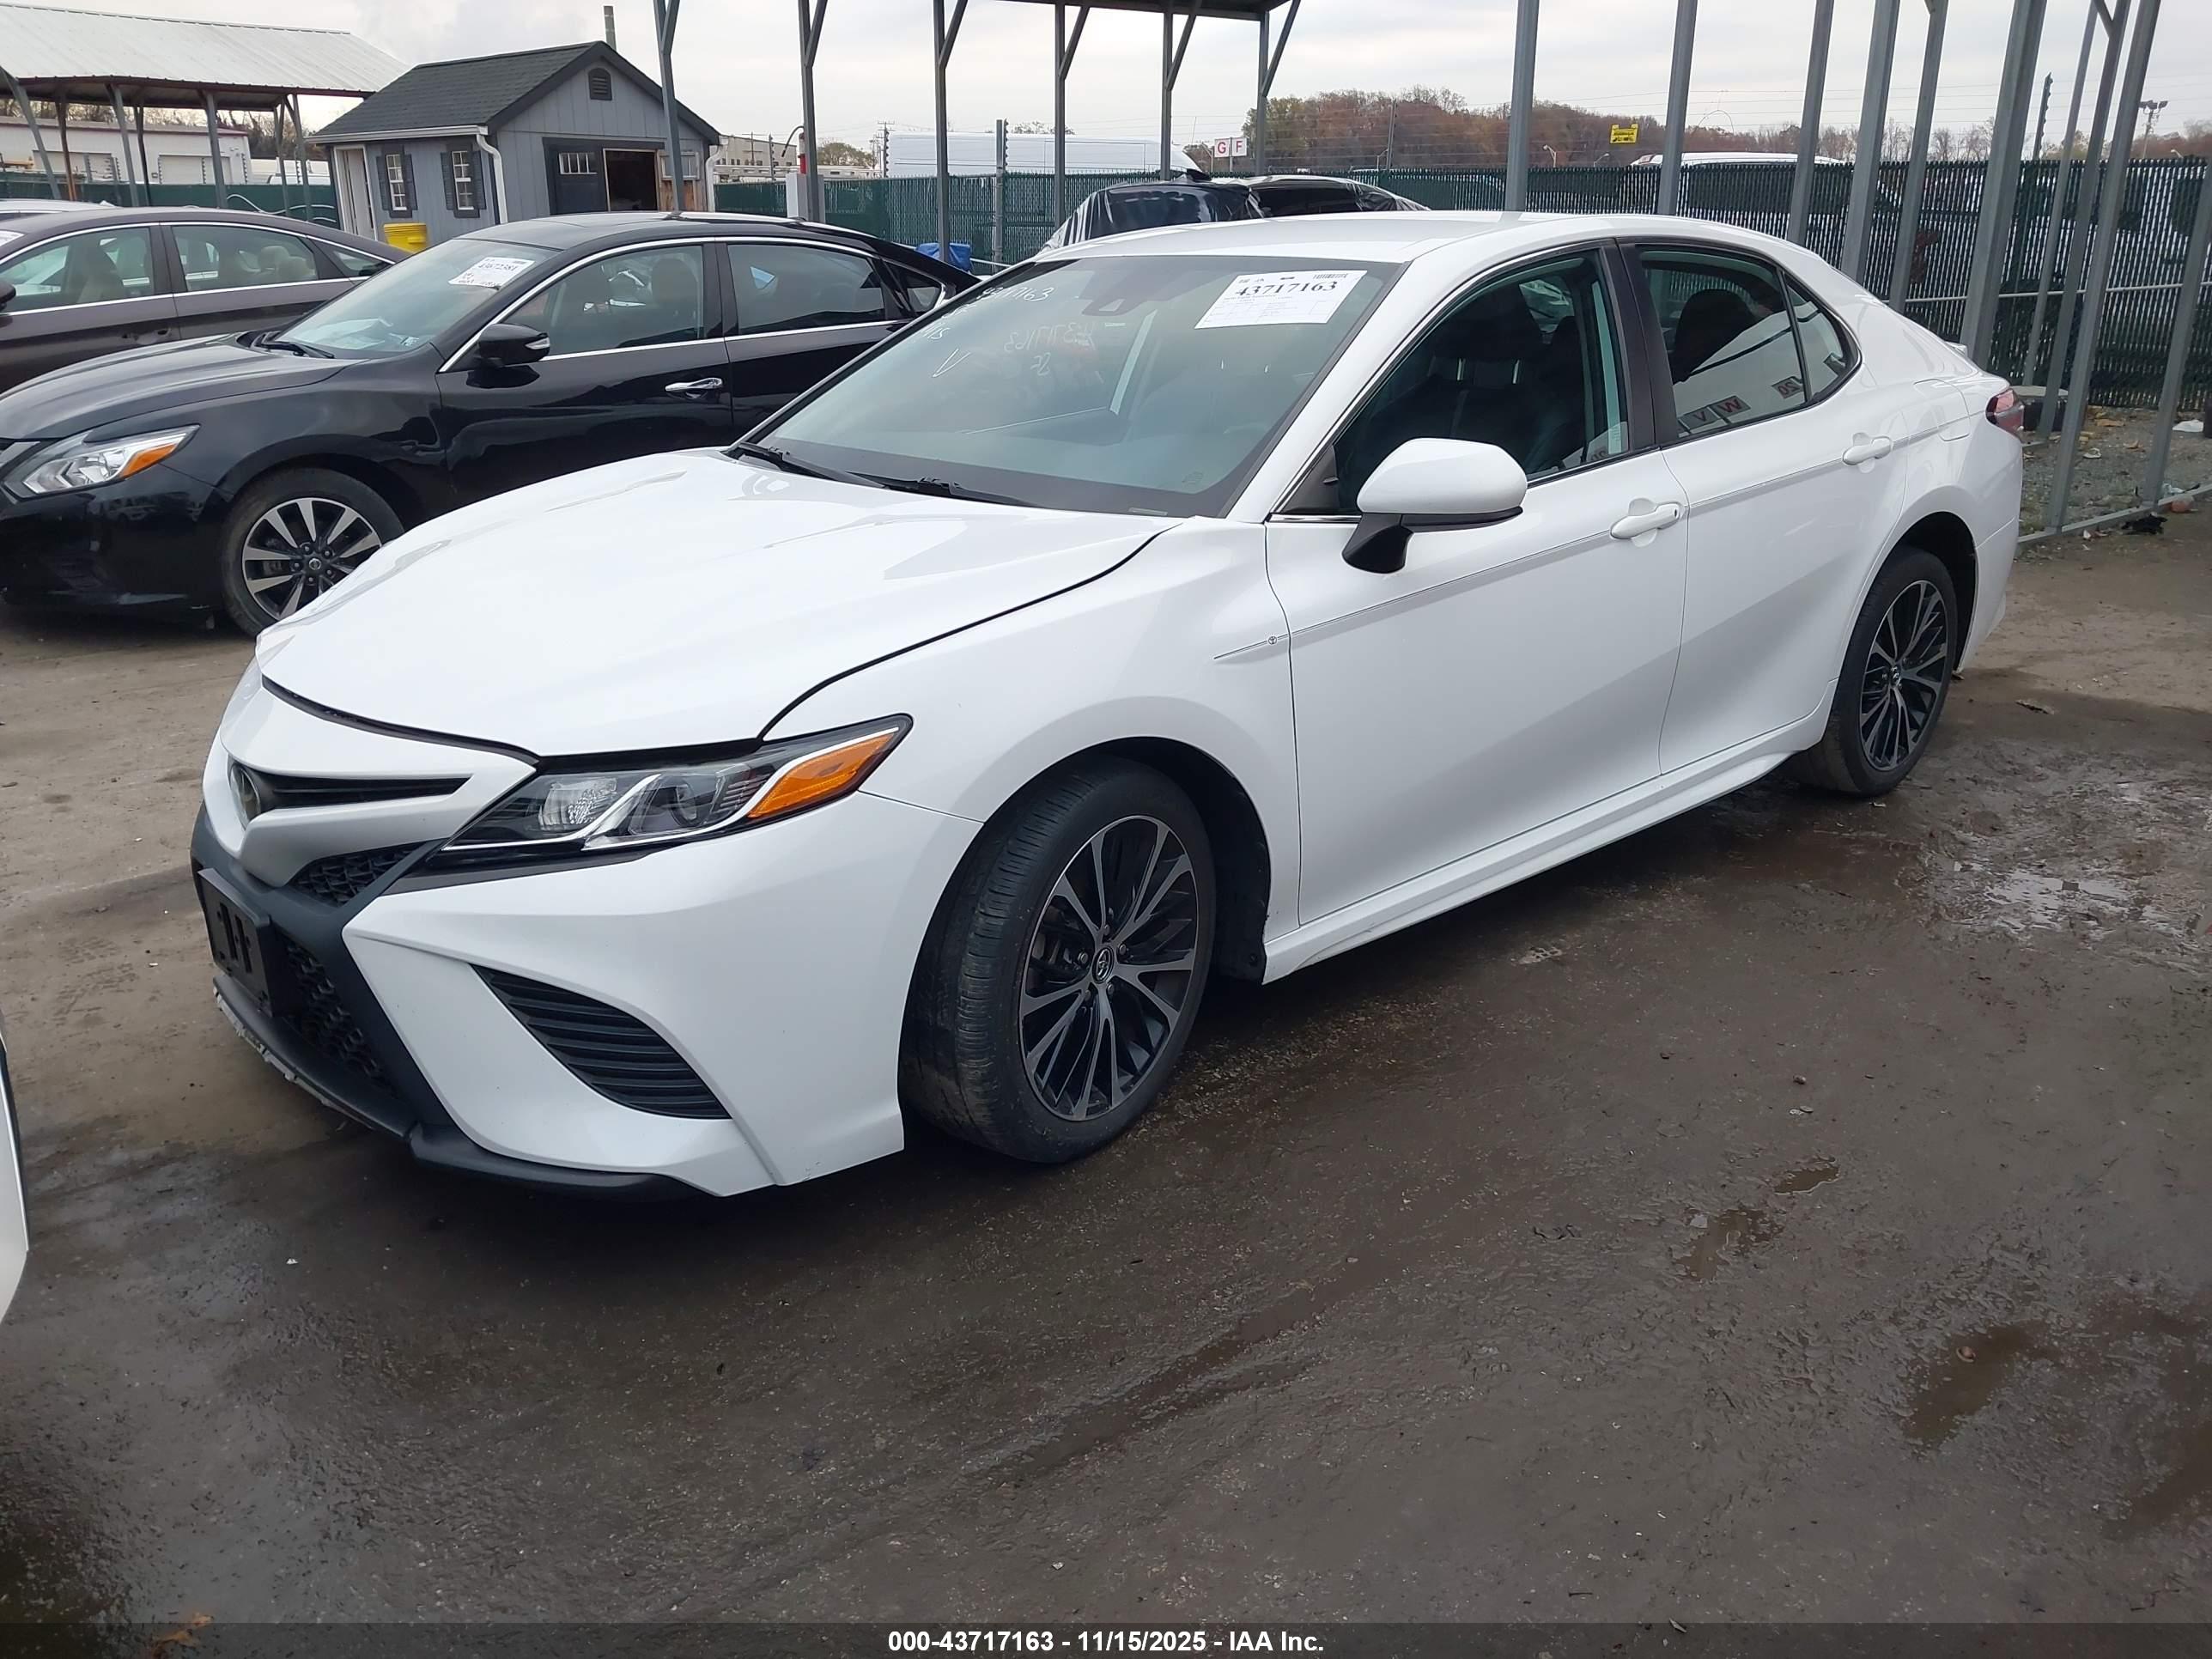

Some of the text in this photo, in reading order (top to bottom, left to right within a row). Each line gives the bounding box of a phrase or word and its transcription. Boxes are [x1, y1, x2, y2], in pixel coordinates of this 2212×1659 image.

[1217, 142, 1226, 154] G
[1236, 140, 1243, 154] F
[1236, 281, 1338, 296] 43717163
